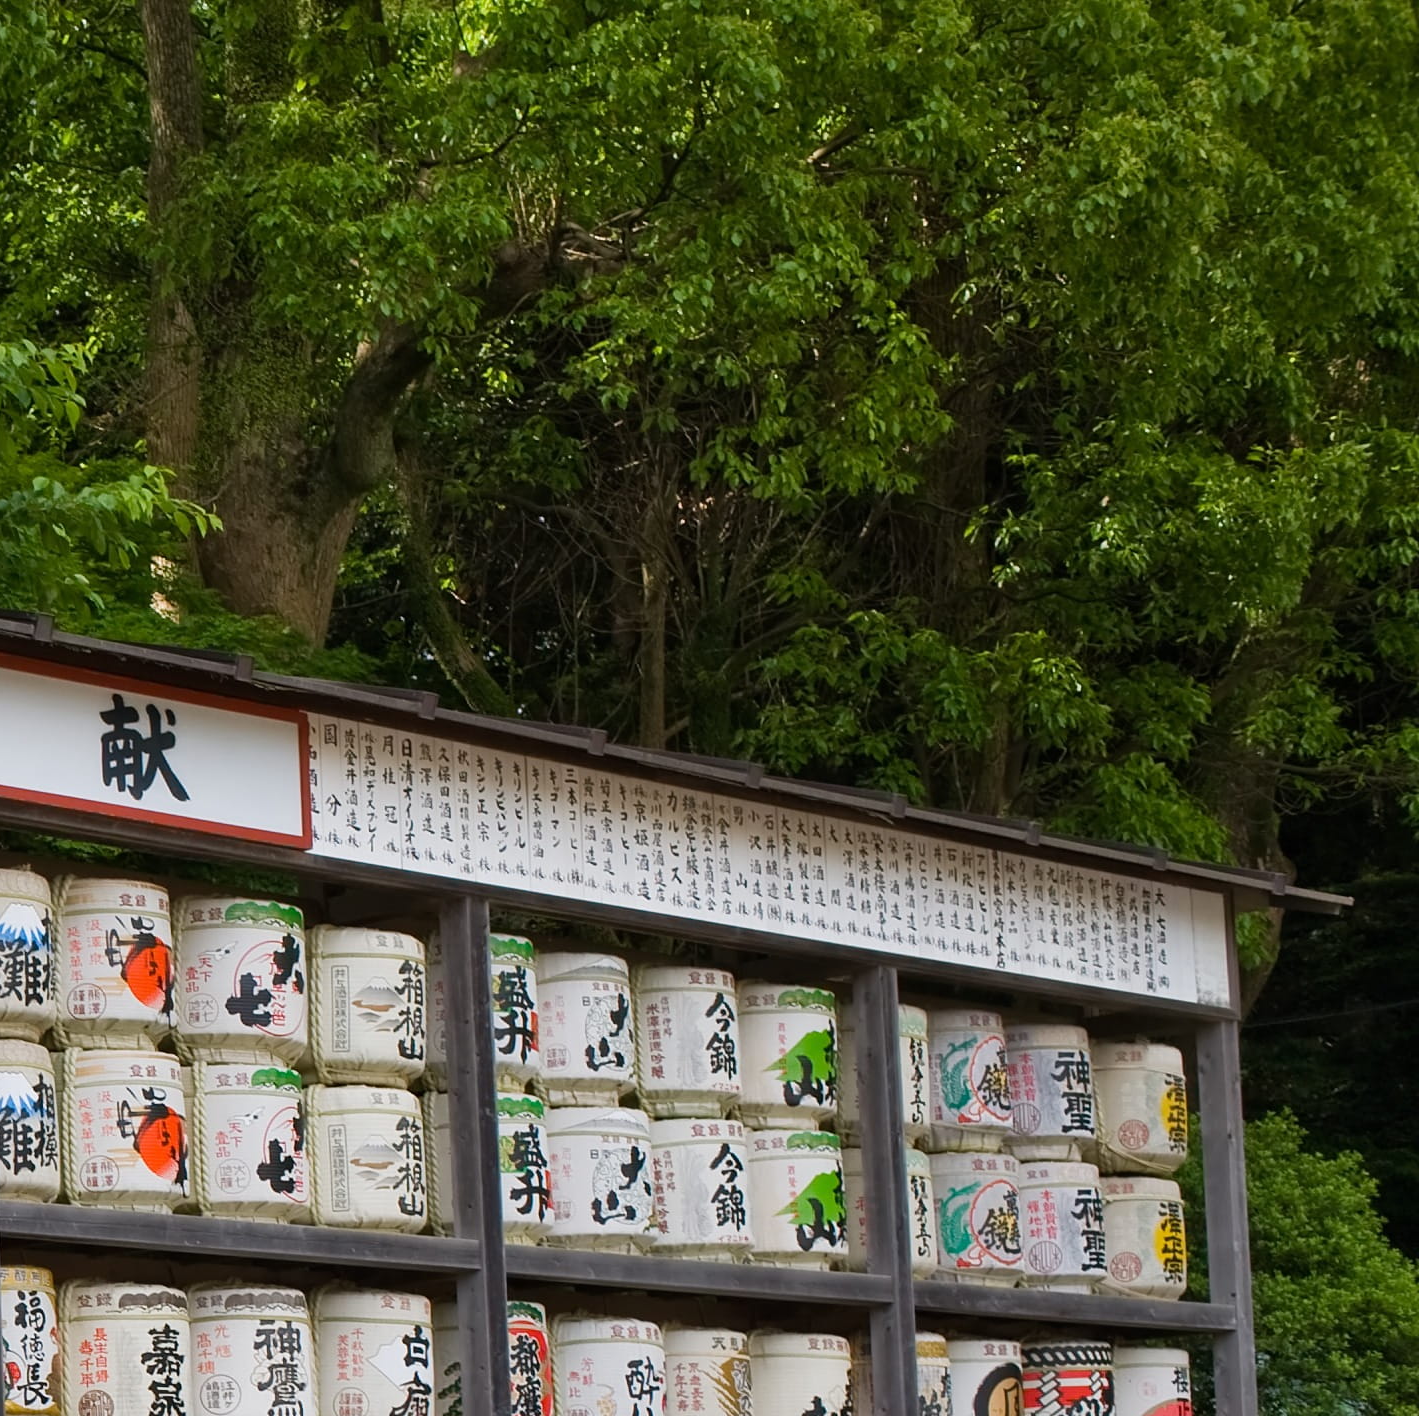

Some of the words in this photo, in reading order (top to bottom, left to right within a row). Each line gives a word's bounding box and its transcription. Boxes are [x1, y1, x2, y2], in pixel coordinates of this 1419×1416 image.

[394, 960, 424, 1061] 箱根山
[706, 993, 736, 1080] 今錦
[1051, 1051, 1094, 1134] 神聖
[393, 1117, 423, 1217] 箱根山
[710, 1144, 745, 1231] 今錦
[1071, 1190, 1107, 1271] 神聖
[15, 1291, 50, 1406] 福徳長
